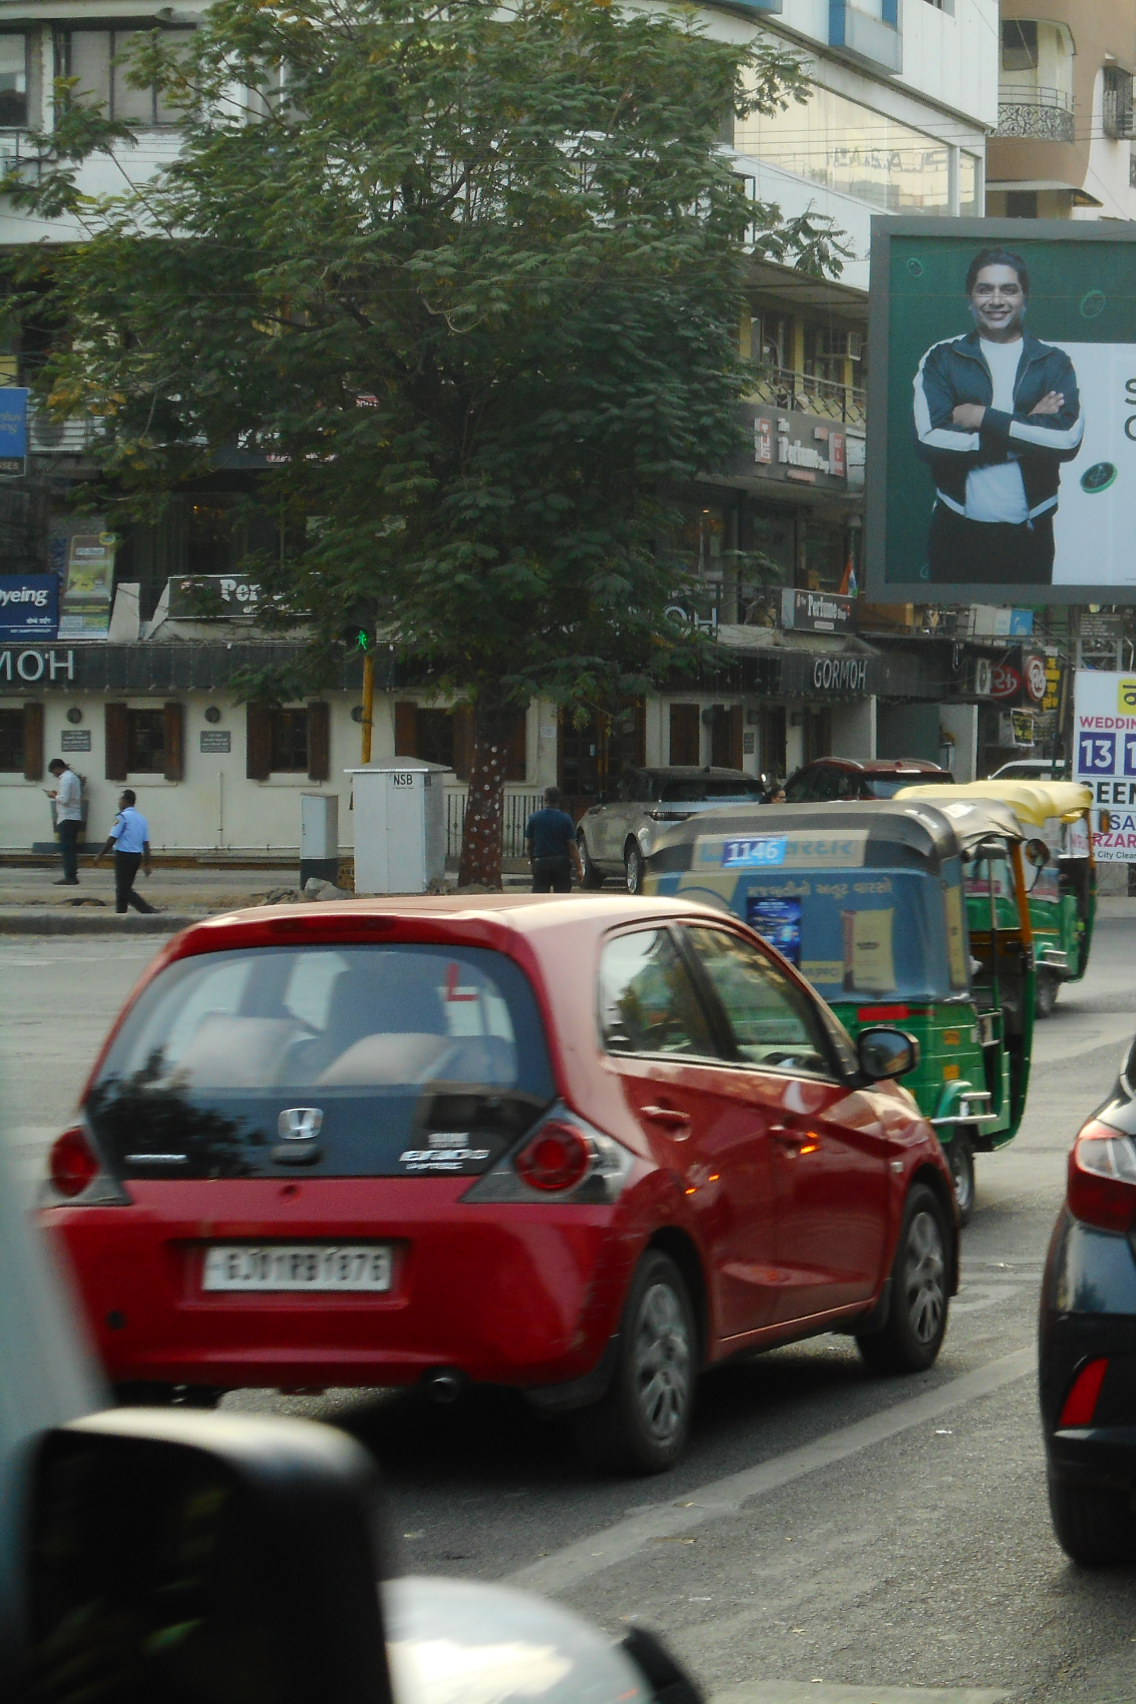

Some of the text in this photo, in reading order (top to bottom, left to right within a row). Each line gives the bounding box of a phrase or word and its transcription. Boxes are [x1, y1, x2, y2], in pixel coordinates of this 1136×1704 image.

[0, 587, 48, 607] yeing
[813, 659, 868, 689] GORMOH
[1081, 740, 1112, 768] 13
[393, 774, 413, 786] NSB
[728, 841, 780, 861] 1146
[1098, 851, 1113, 861] City
